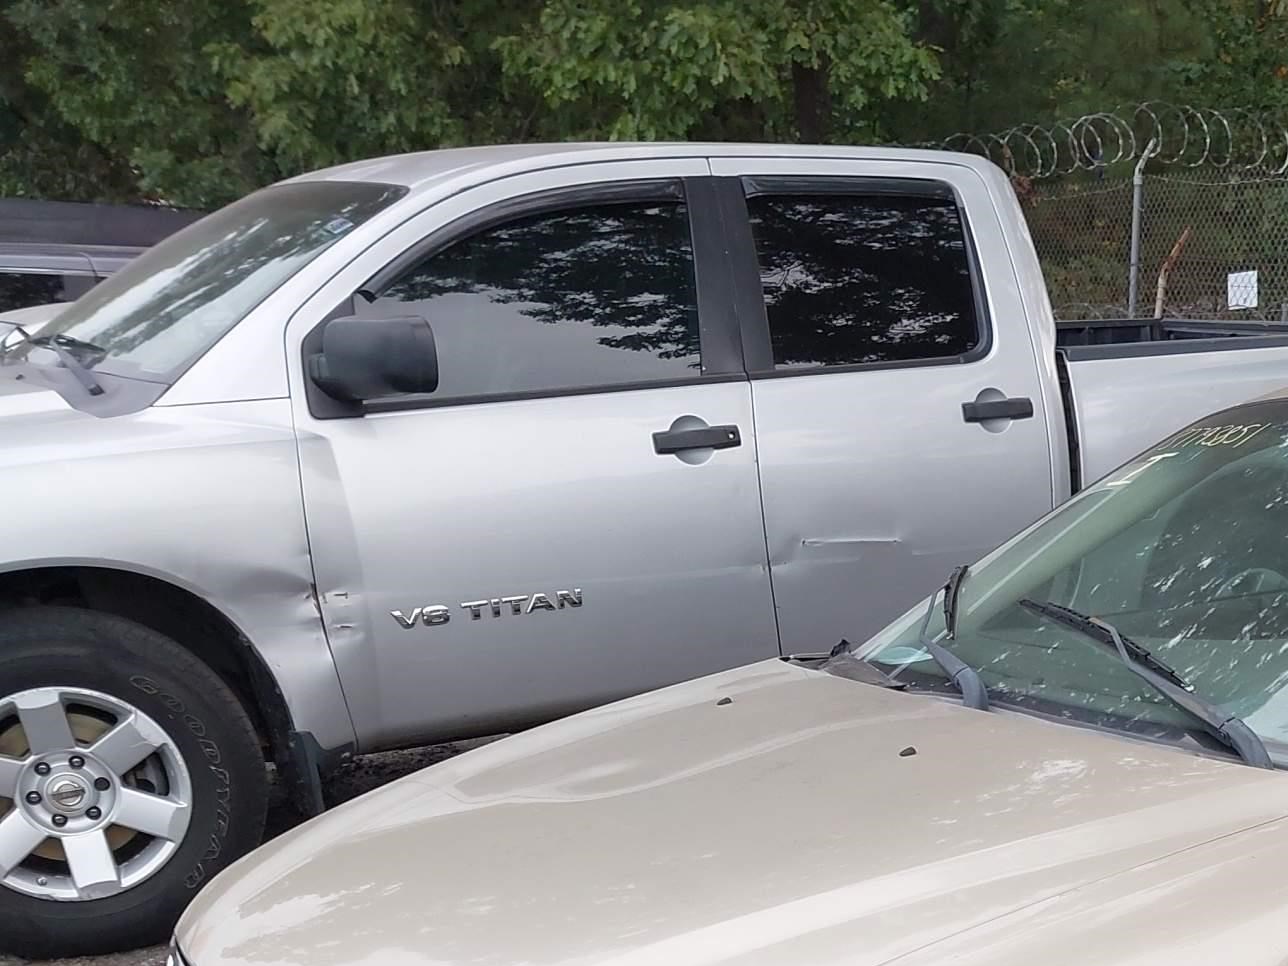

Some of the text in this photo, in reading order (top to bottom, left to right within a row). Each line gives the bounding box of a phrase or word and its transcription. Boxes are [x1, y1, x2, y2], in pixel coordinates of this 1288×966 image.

[390, 587, 583, 630] V8 TITAN
[128, 674, 230, 889] GOODYEAR
